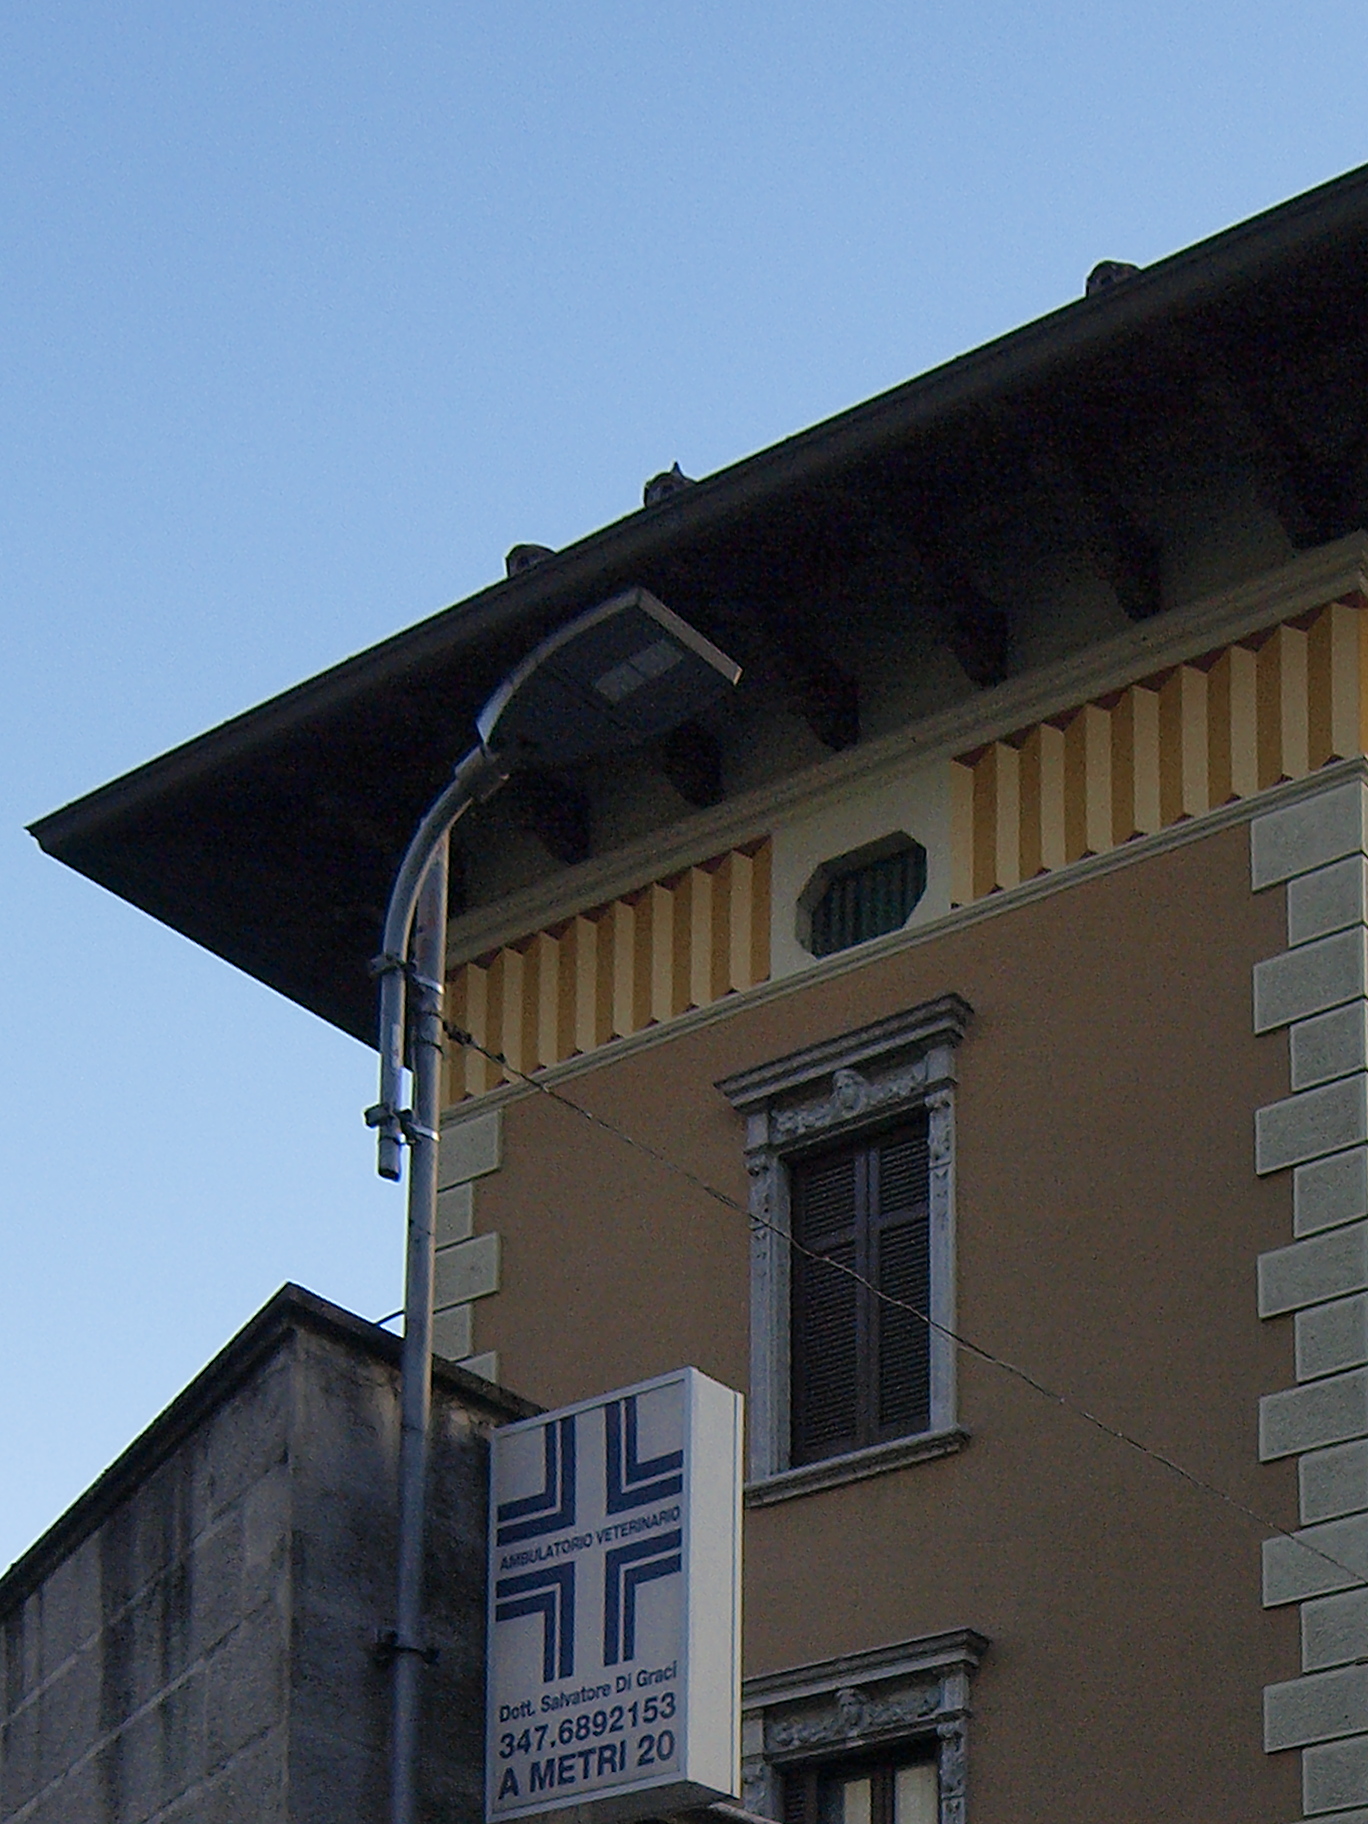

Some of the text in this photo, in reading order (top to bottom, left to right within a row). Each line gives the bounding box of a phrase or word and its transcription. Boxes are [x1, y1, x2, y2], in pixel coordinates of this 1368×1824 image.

[500, 1506, 681, 1570] AMBULATORIO VETERINARIO
[499, 1660, 677, 1722] Dott. Salvatore Di Graci
[499, 1691, 676, 1759] 347.6892153
[498, 1729, 676, 1799] A METRI 20
